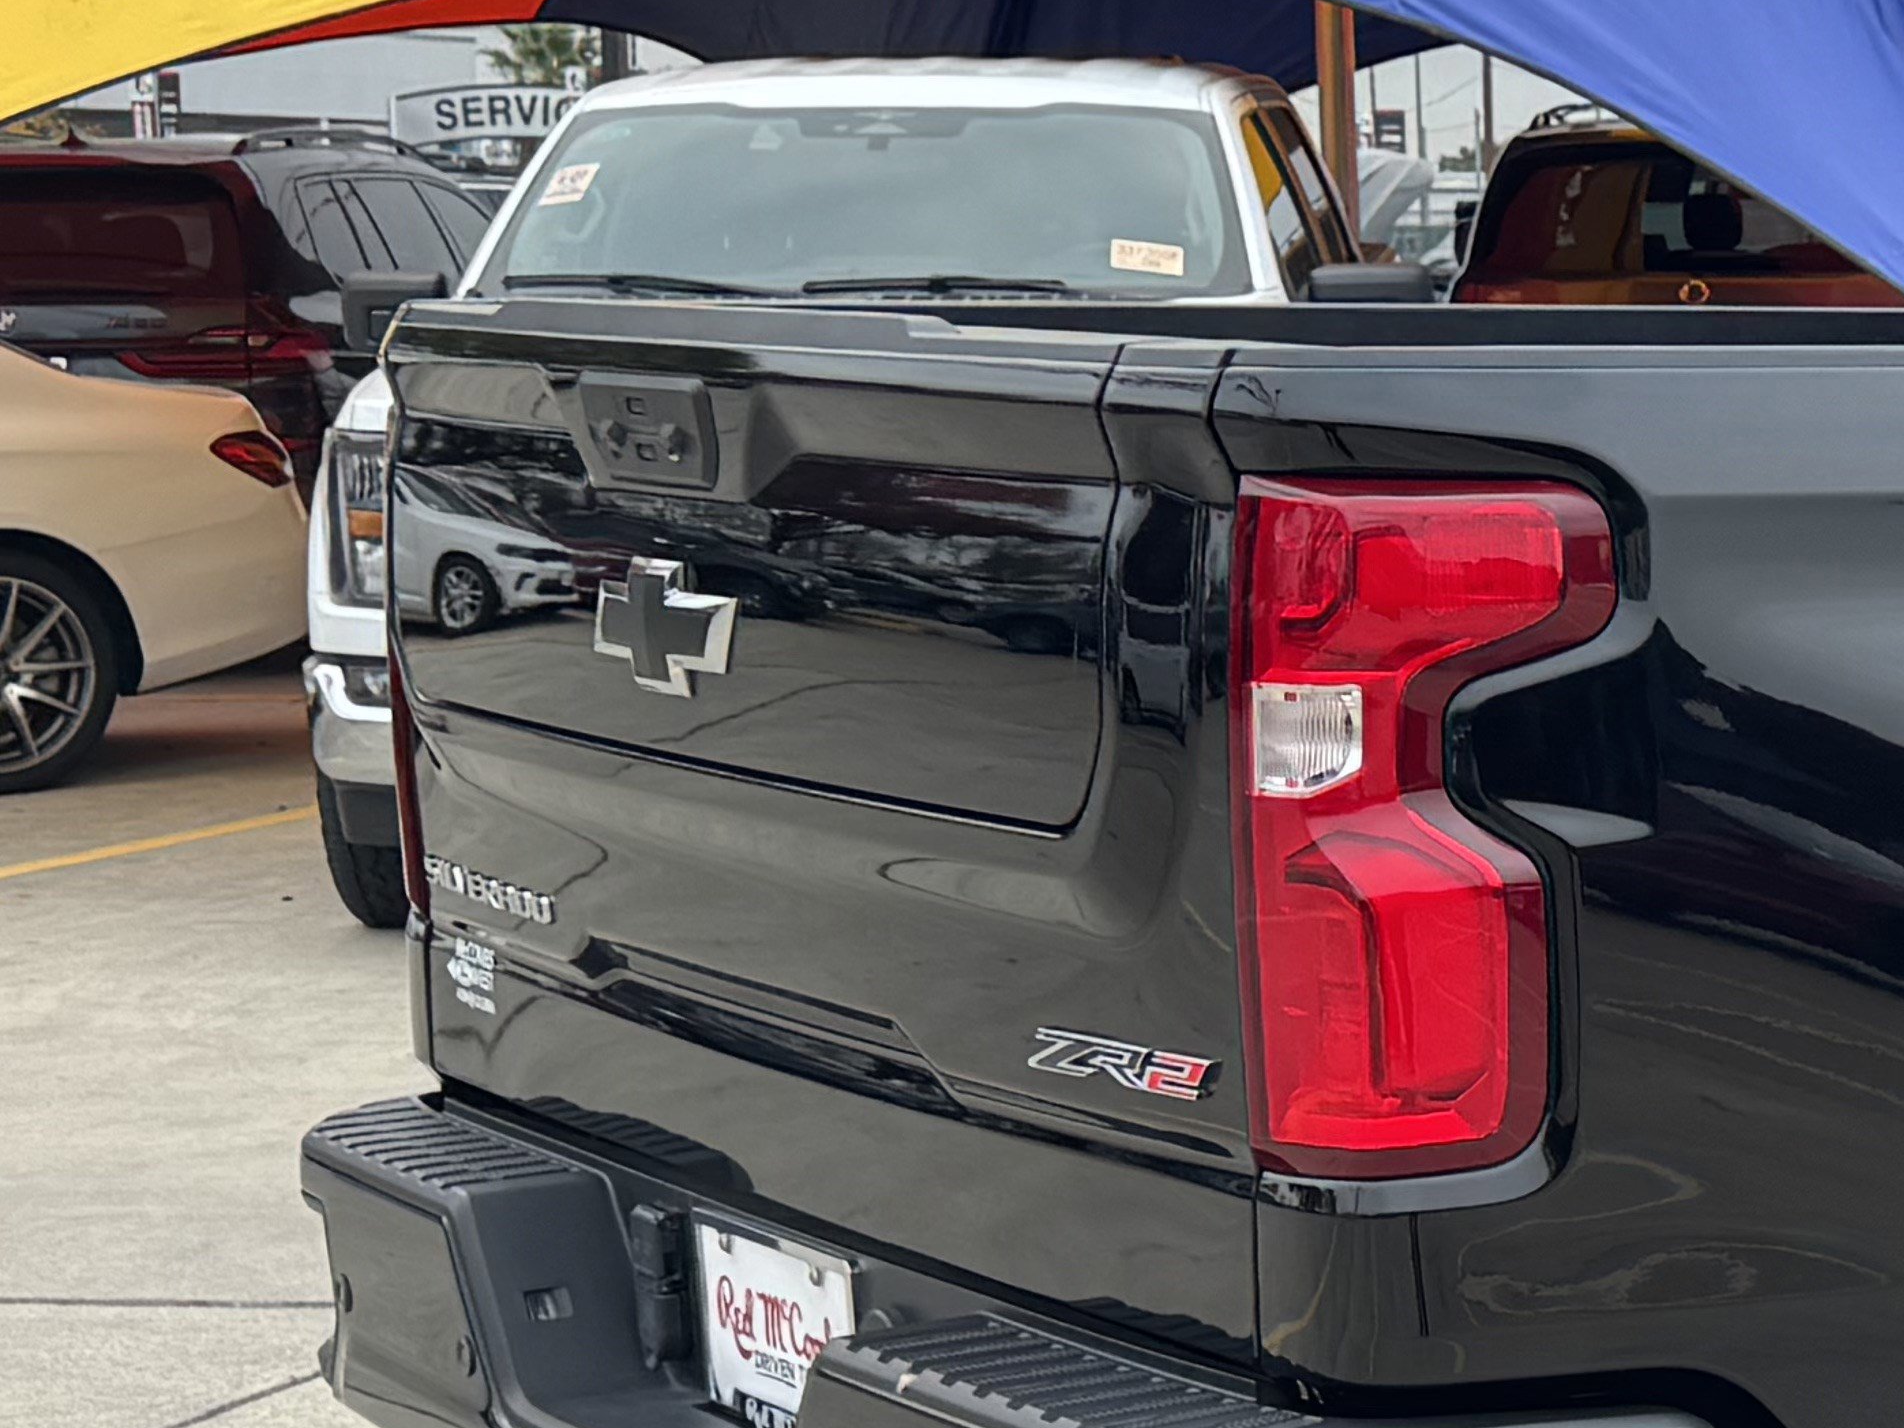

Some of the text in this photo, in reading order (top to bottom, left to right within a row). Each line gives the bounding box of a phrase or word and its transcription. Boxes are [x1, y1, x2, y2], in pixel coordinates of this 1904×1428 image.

[434, 94, 584, 130] SERVIC
[1027, 1026, 1214, 1102] ZR2
[717, 1275, 757, 1360] Red
